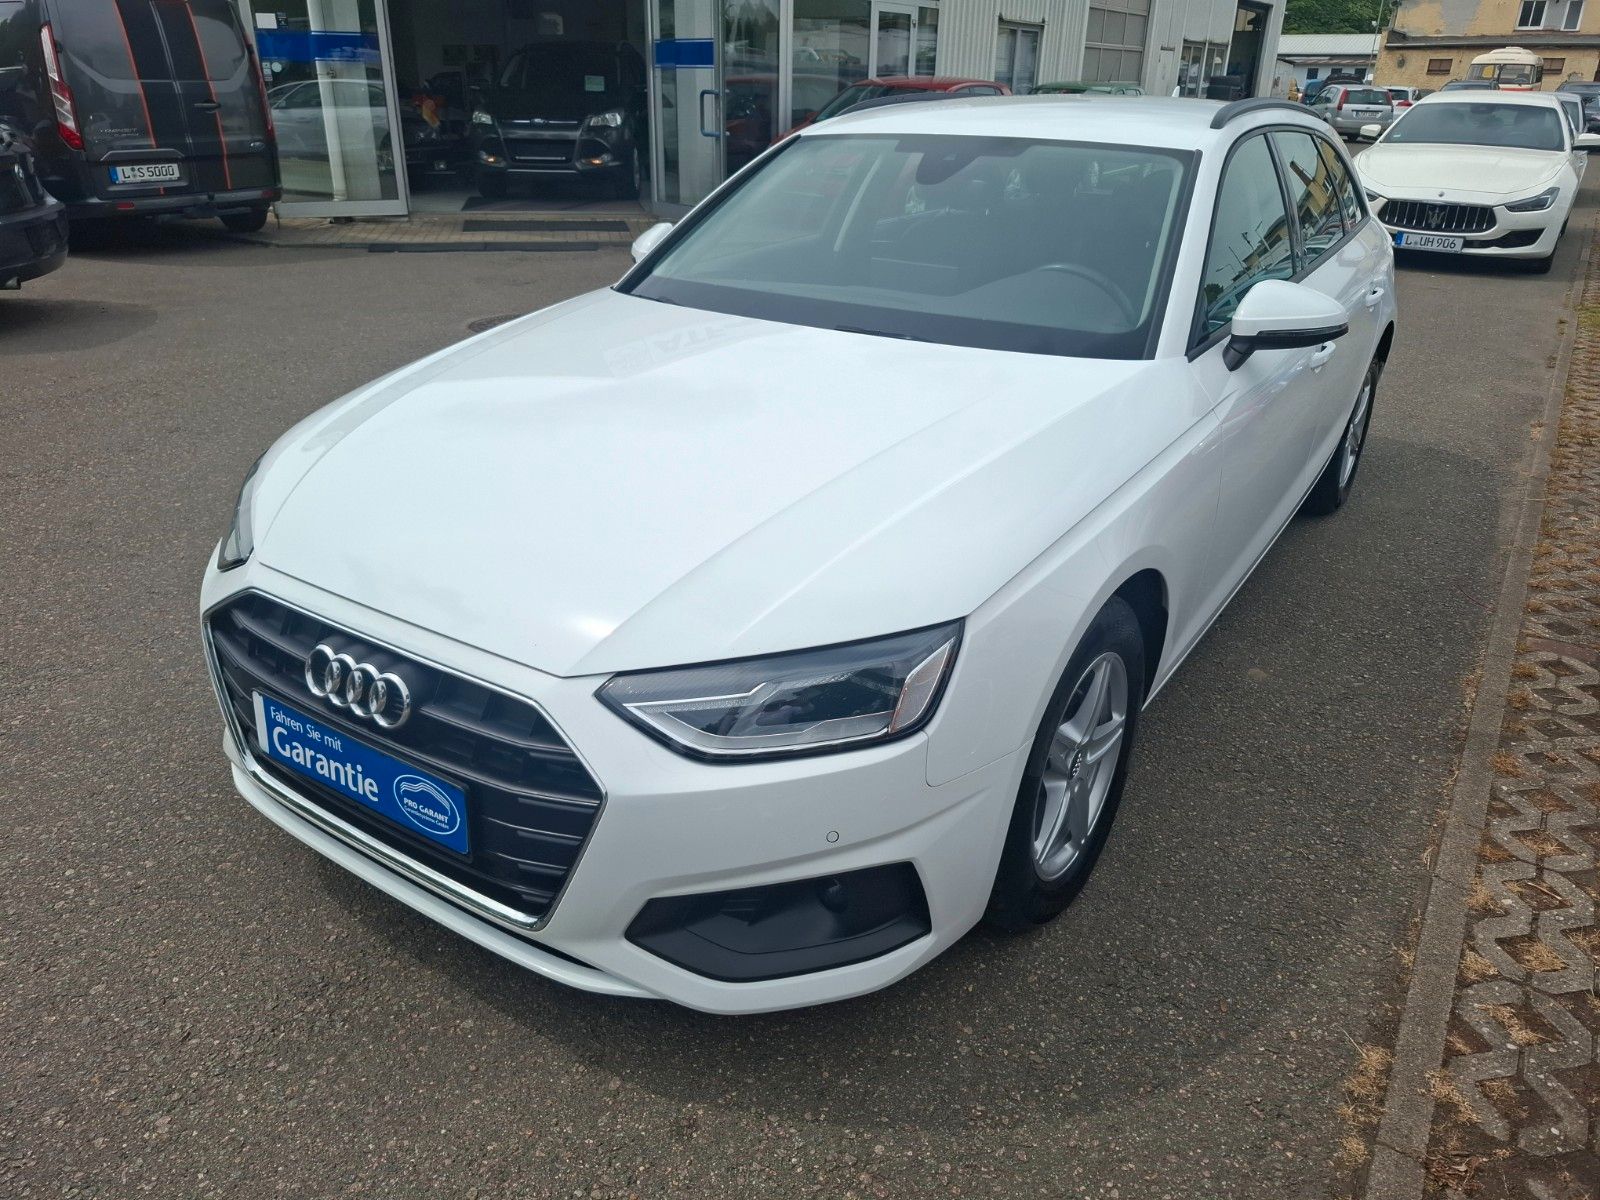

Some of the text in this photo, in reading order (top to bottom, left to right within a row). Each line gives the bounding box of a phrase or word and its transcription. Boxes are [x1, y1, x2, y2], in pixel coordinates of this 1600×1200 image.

[122, 165, 175, 179] L S 5000
[1405, 235, 1457, 249] L UH 906
[270, 706, 343, 753] Fahren Sie mit
[272, 727, 379, 802] Garantie
[403, 797, 449, 823] PRO GARANT
